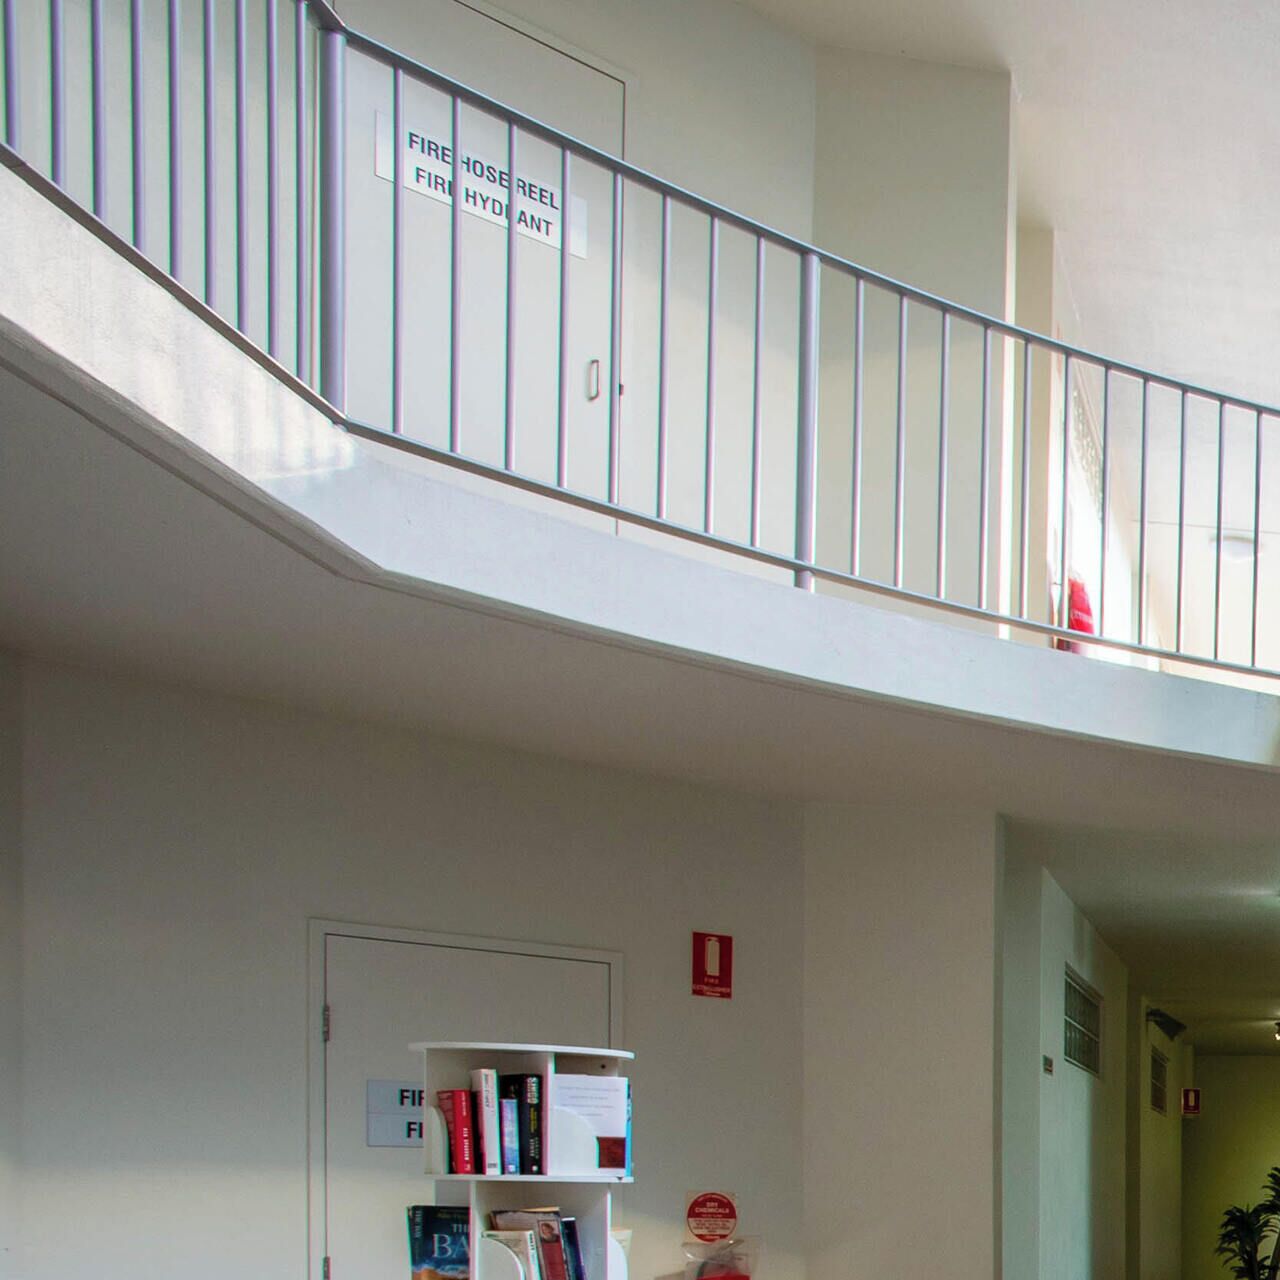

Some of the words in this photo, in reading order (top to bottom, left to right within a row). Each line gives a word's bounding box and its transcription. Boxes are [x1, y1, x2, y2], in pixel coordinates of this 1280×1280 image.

[408, 131, 454, 166] FIRE
[515, 177, 560, 211] REEL
[432, 1233, 469, 1258] BA
